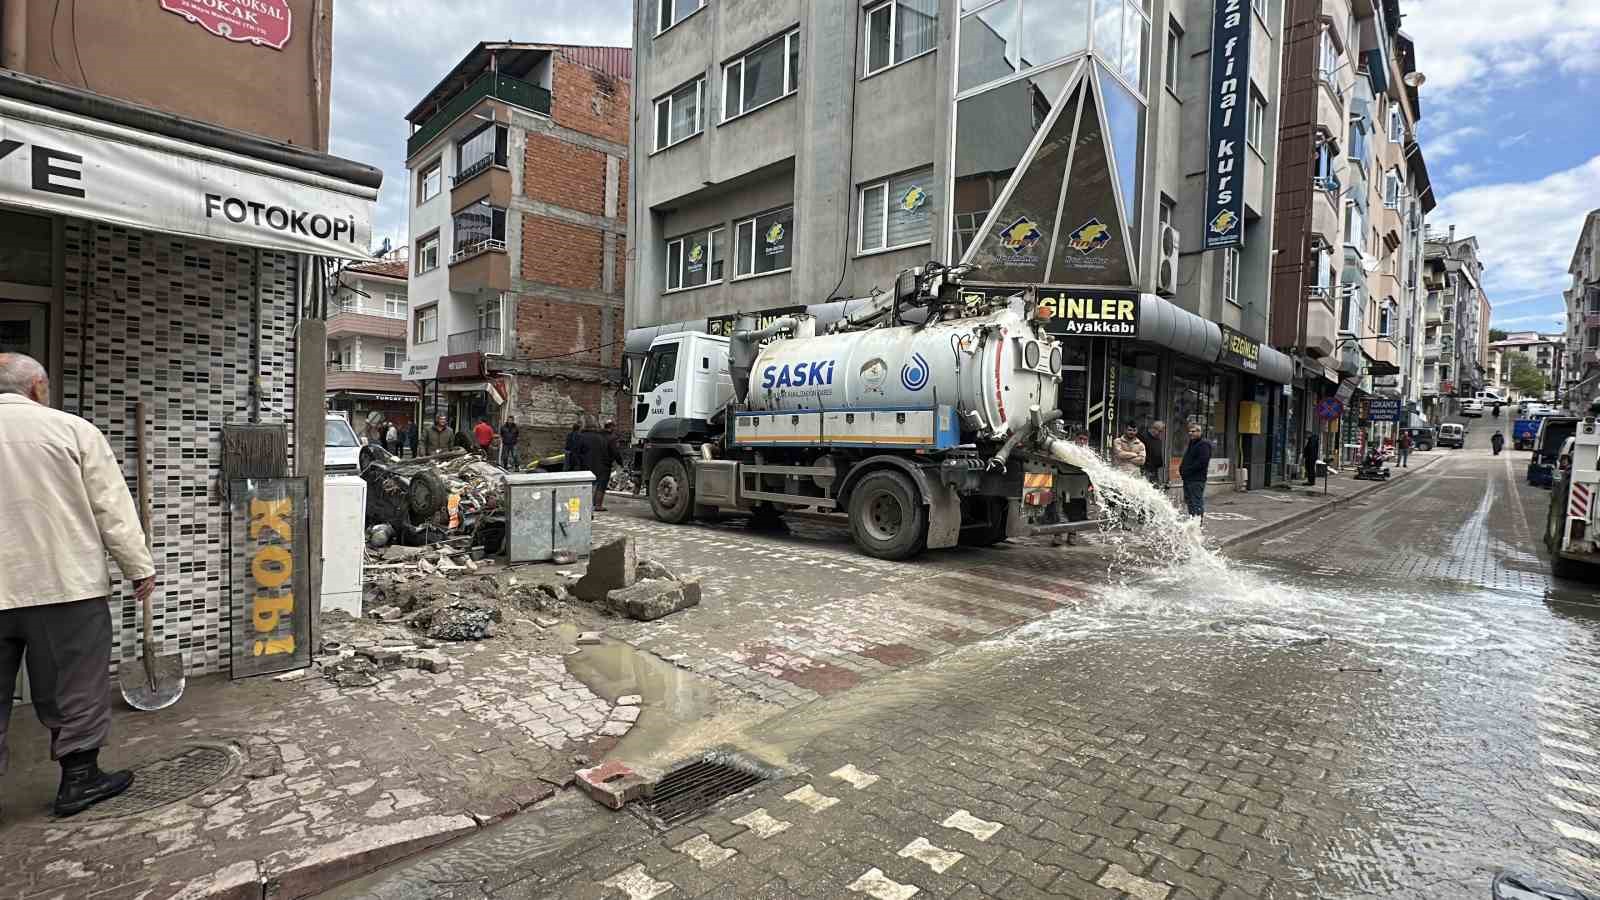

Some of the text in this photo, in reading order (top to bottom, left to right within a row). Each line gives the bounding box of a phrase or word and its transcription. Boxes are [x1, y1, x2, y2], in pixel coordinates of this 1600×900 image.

[1220, 37, 1238, 127] final
[1217, 140, 1235, 205] kurs
[205, 193, 355, 243] FOTOKOPİ
[1067, 321, 1134, 333] Ayakkabı
[762, 360, 835, 389] SASKİ
